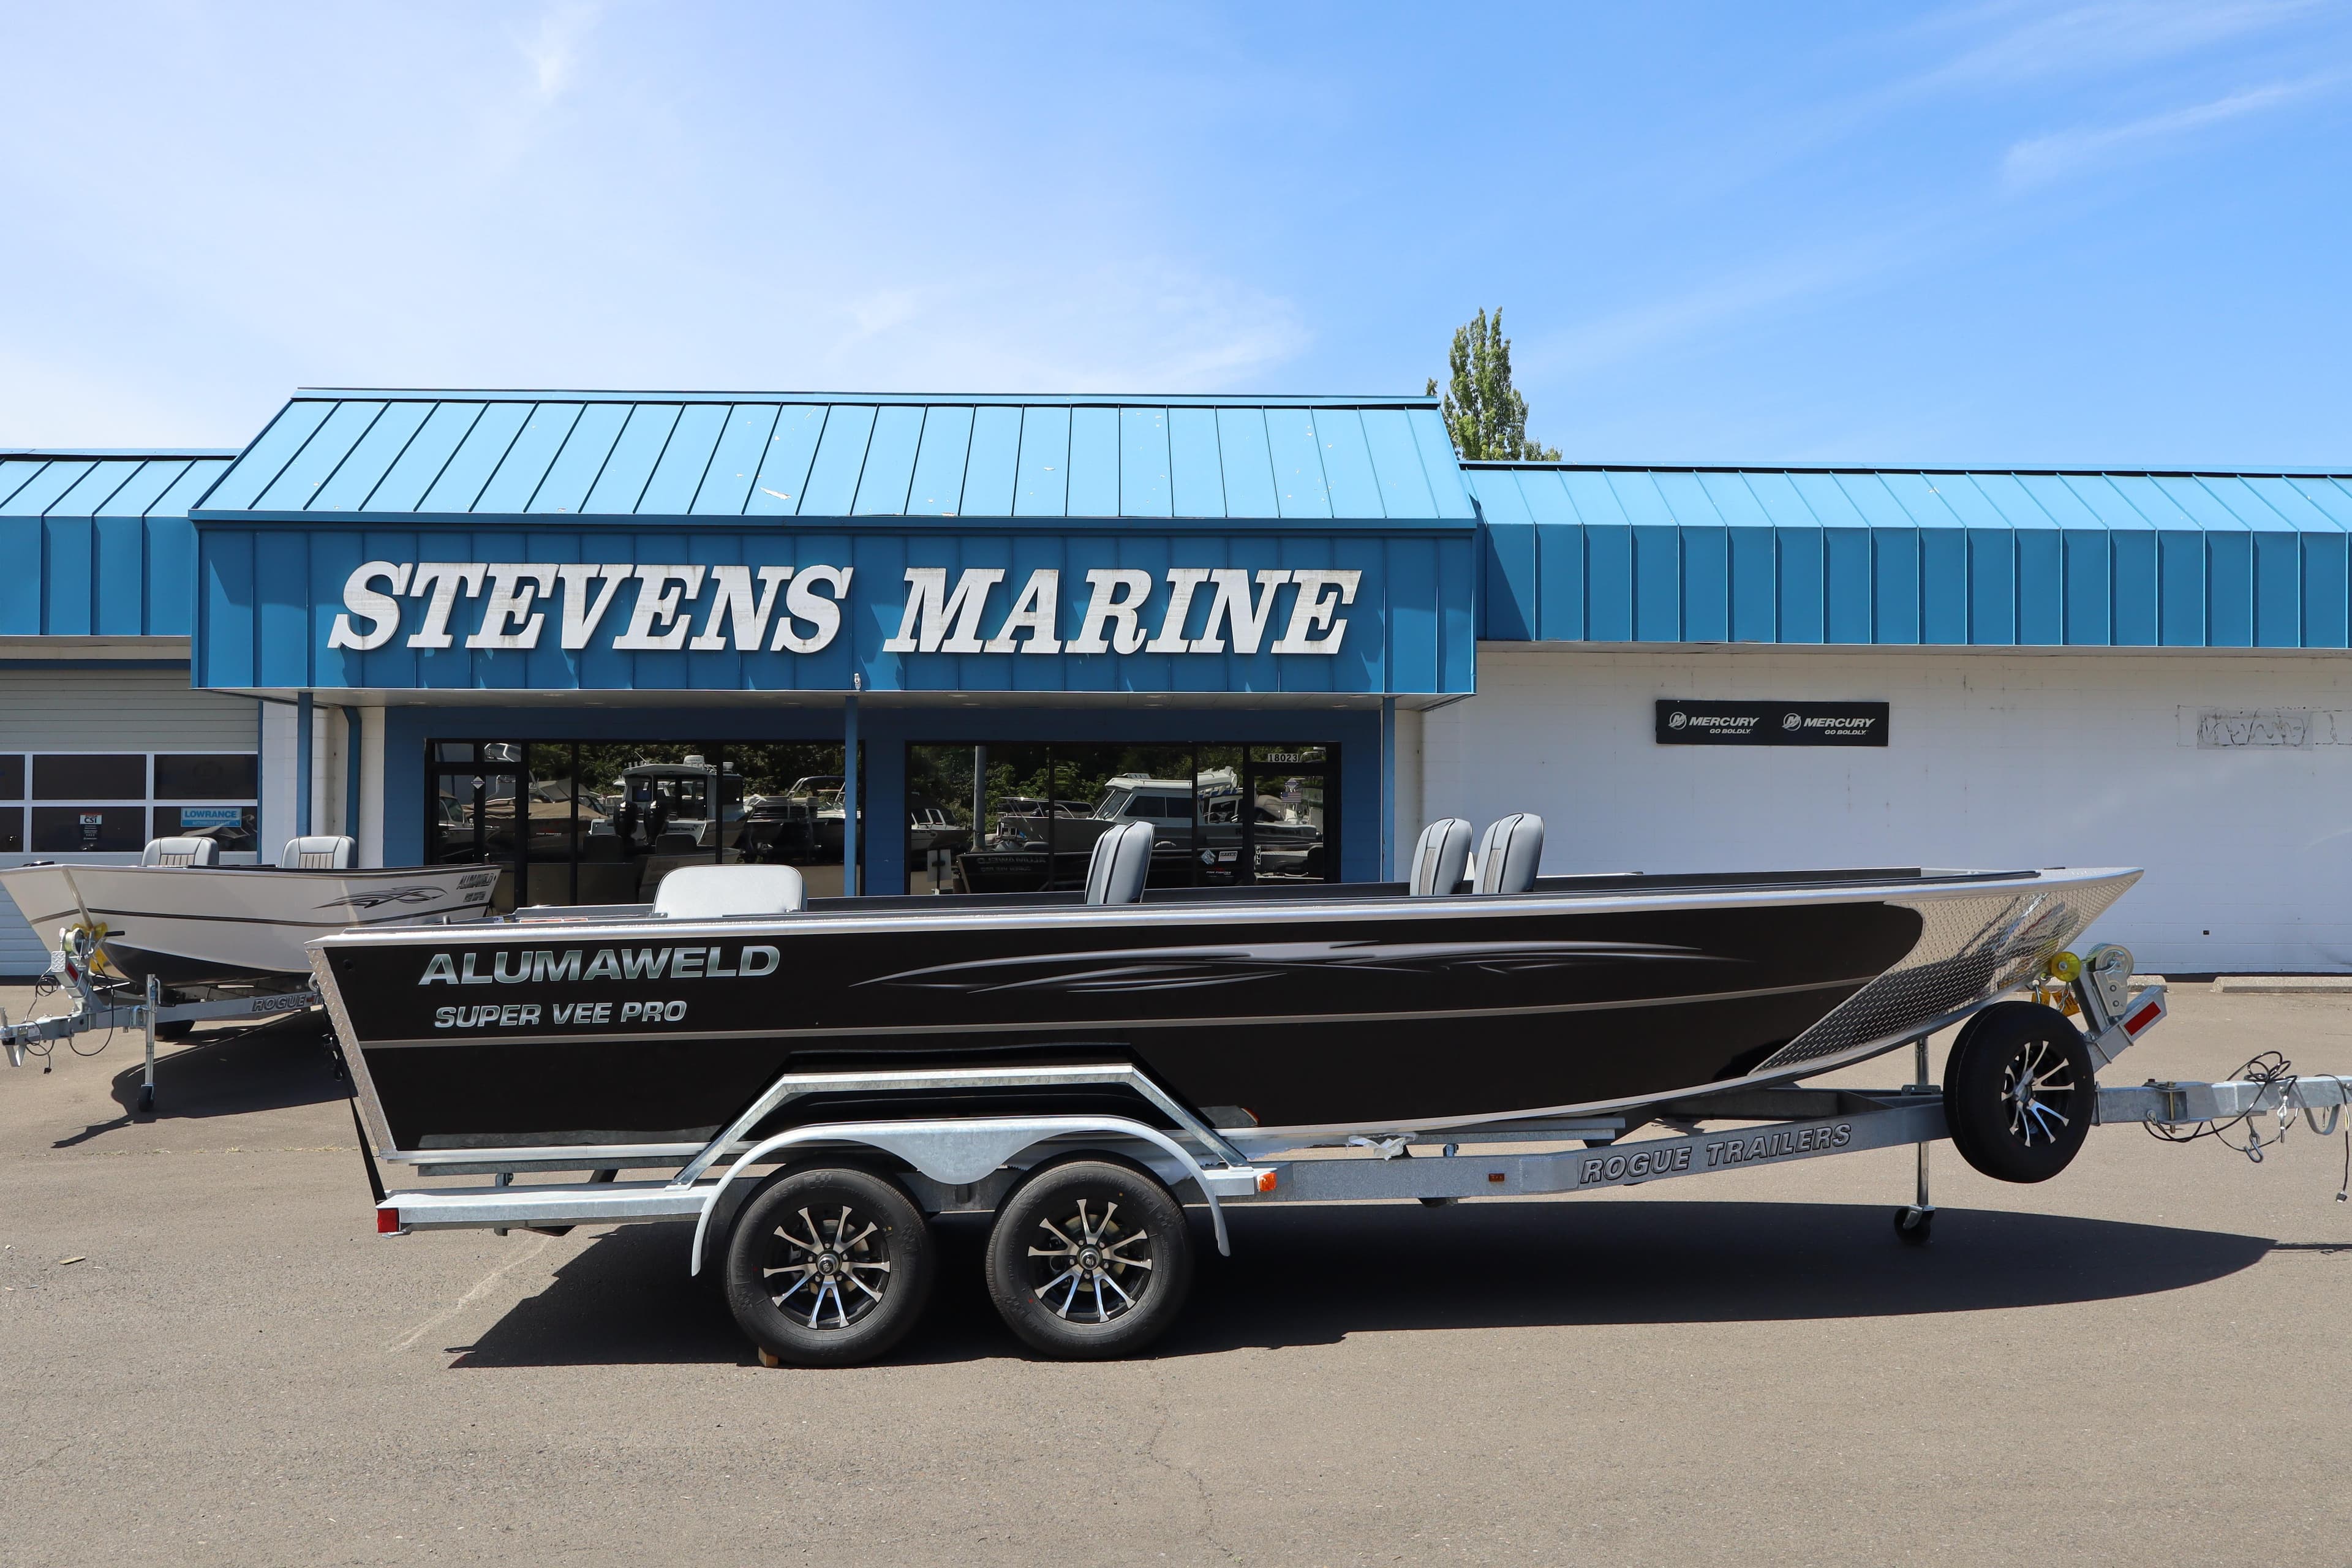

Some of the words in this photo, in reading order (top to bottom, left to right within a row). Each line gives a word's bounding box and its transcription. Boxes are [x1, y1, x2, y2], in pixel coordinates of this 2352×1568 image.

[328, 560, 854, 654] STEVENS
[883, 567, 1362, 654] MARINE
[1689, 717, 1759, 726] MERCURY
[1804, 717, 1875, 728] MERCURY
[418, 946, 780, 985] ALUMAWELD
[252, 994, 305, 1012] ROGUE
[435, 1005, 541, 1028] SUPER
[552, 1003, 612, 1024] VEE
[620, 1001, 687, 1023] PRO
[1580, 1146, 1692, 1183] ROGUE
[1706, 1124, 1851, 1166] TRAILERS
